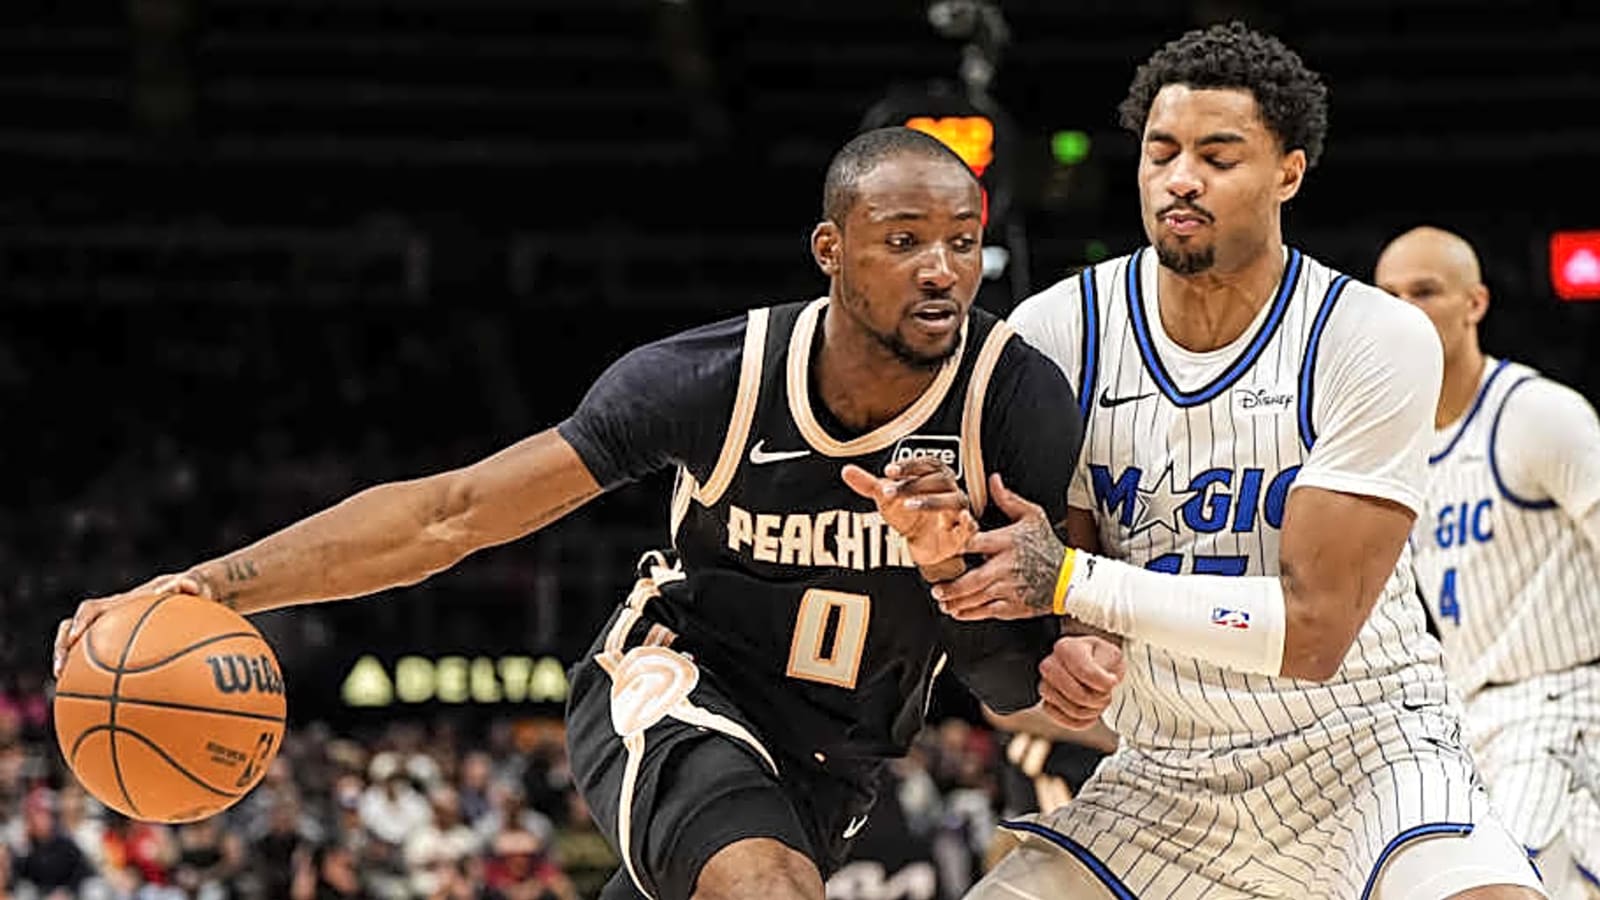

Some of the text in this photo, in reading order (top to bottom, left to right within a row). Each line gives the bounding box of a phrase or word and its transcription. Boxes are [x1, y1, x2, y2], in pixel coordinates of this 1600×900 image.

[1235, 389, 1294, 411] Disney
[727, 505, 915, 570] PEACHTR
[1435, 498, 1494, 549] GIC
[786, 588, 871, 690] 0
[395, 655, 569, 704] DELTA
